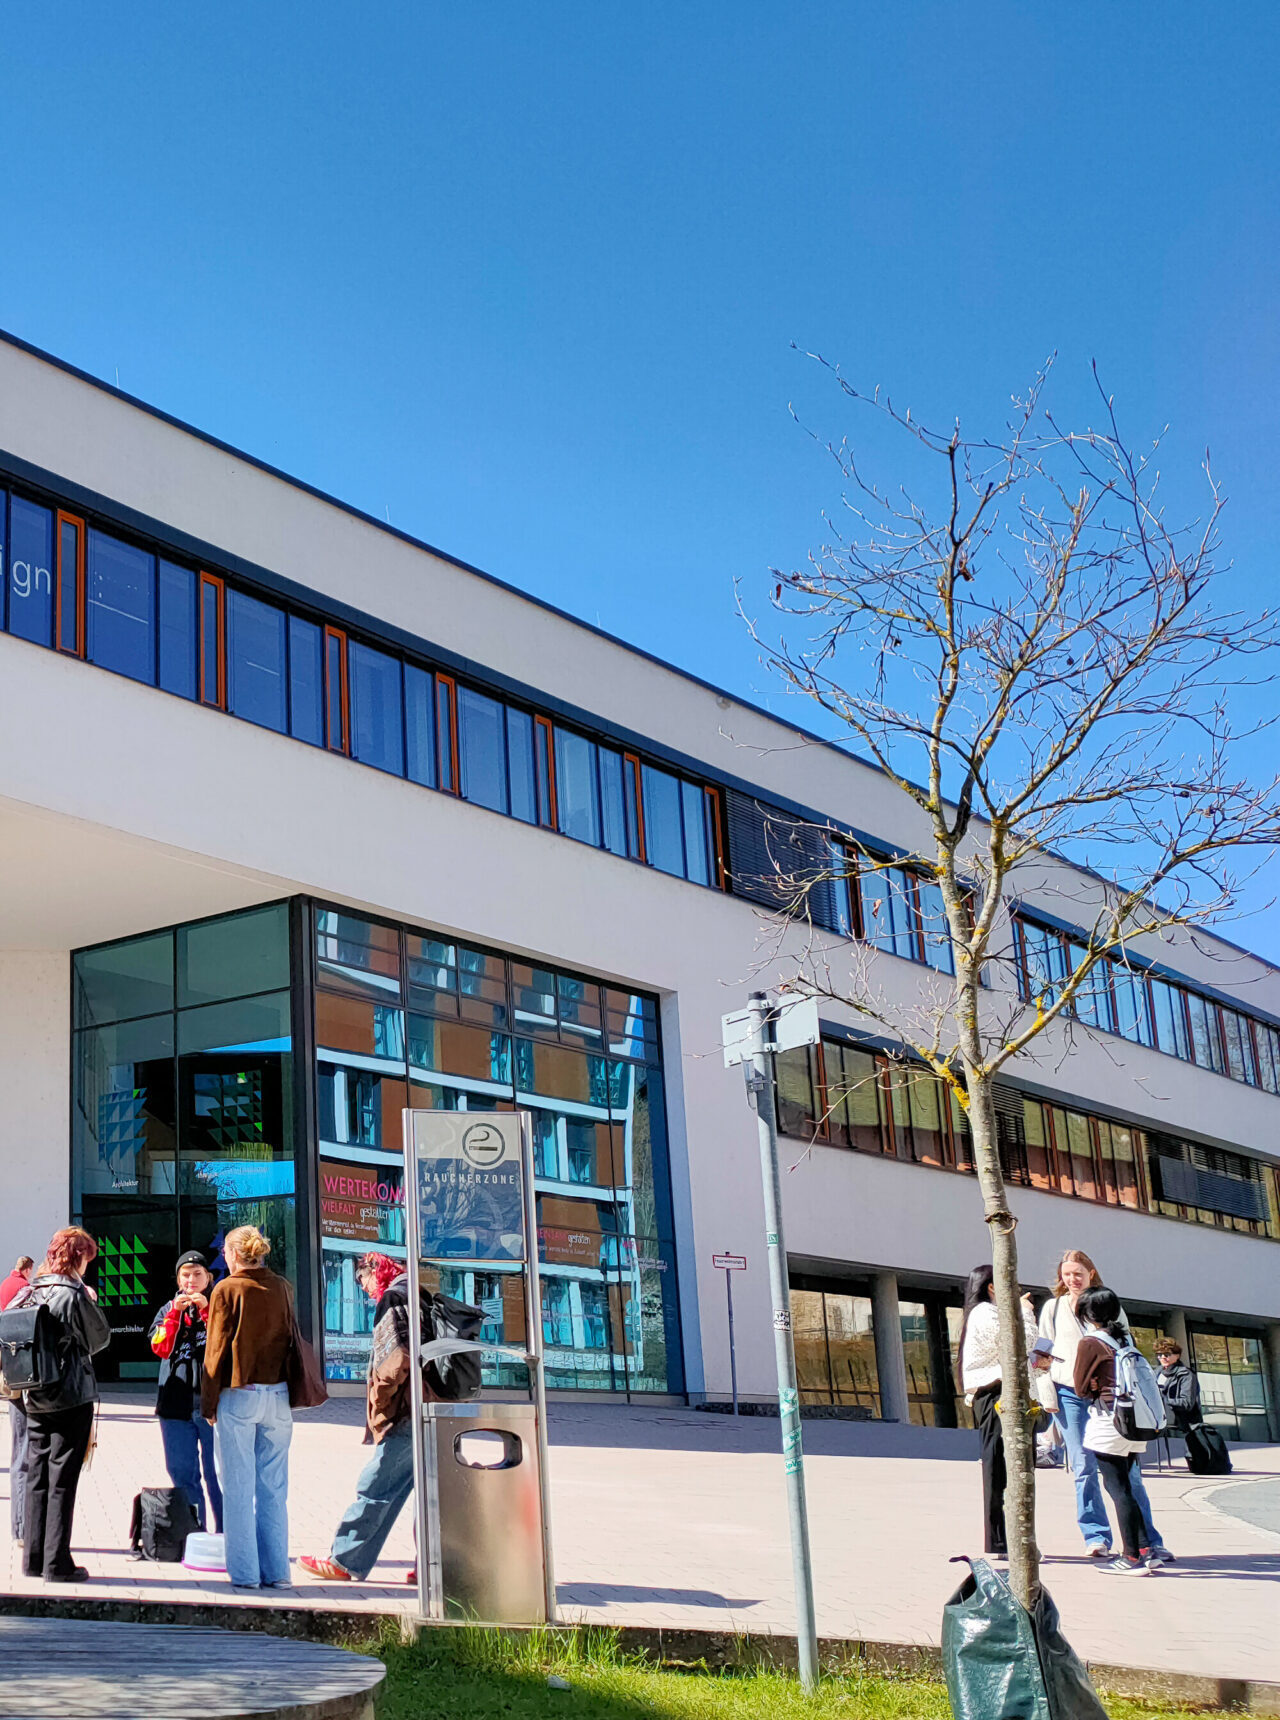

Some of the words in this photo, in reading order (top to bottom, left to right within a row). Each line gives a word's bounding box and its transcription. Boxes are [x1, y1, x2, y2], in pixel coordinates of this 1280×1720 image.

[424, 1172, 516, 1185] RAUCHERZONE
[321, 1200, 357, 1216] VIELFALT
[360, 1206, 388, 1222] gestalten
